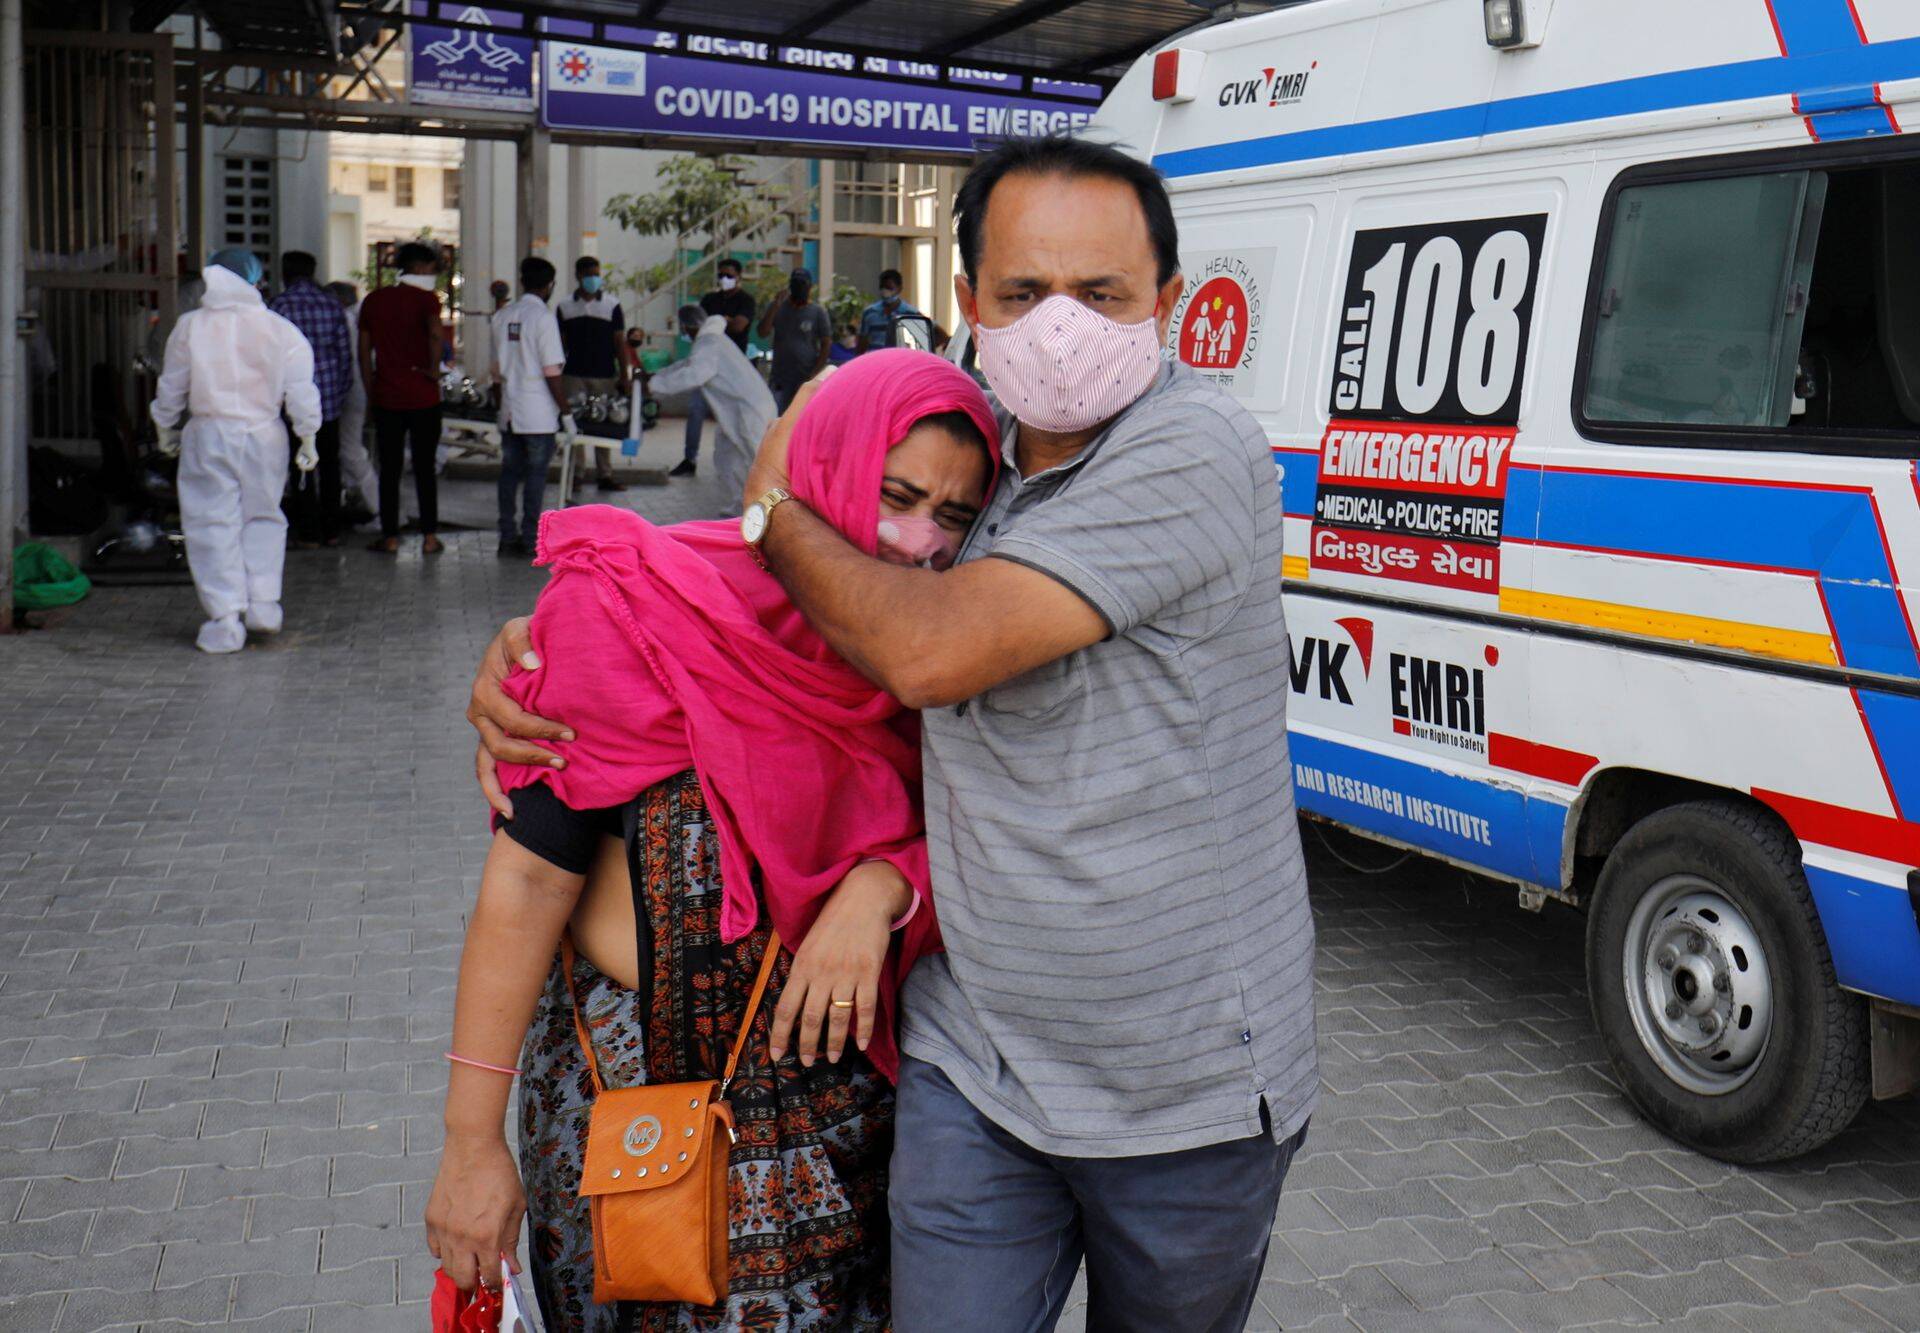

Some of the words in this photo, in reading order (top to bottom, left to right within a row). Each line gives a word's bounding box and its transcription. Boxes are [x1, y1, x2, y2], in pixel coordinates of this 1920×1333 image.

[655, 85, 800, 123] COVID-19
[808, 95, 960, 132] HOSPITAL
[967, 106, 1098, 139] EMERGE
[1219, 79, 1263, 107] GVK
[1271, 72, 1309, 100] EMRI
[1205, 256, 1249, 282] HEALTH
[1241, 277, 1260, 369] MISSION
[1359, 230, 1531, 416] 108
[1336, 299, 1371, 411] CALL
[1323, 430, 1510, 487] EMERGENCY
[1395, 502, 1452, 532] POLICE
[1461, 508, 1499, 537] FIRE
[1431, 544, 1493, 580] સેવા
[1287, 633, 1354, 706] VK
[1390, 652, 1485, 736] EMRI
[1411, 724, 1428, 740] Your
[1429, 728, 1449, 745] Right
[1450, 734, 1458, 747] to
[1296, 764, 1326, 793] AND
[1326, 772, 1405, 817] RESEARCH
[1406, 795, 1492, 847] INSTITUTE
